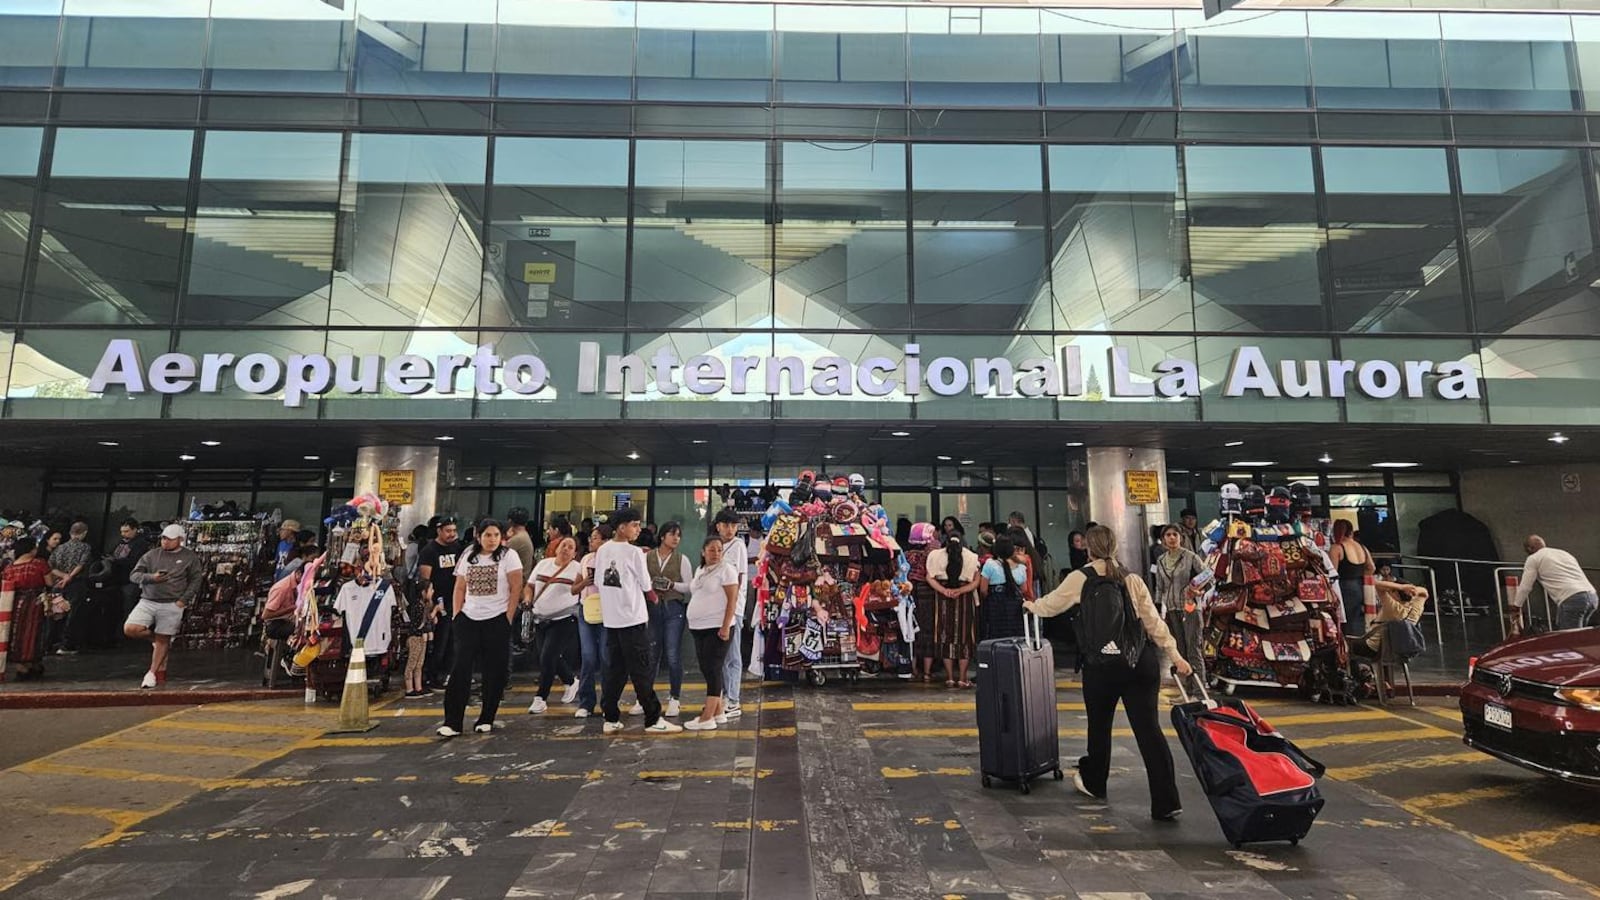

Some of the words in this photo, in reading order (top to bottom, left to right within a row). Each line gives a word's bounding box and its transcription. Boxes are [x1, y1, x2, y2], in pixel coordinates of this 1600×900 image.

[87, 339, 549, 408] Aeropuerto
[577, 341, 1083, 397] Internacional
[1107, 346, 1200, 398] La
[1223, 346, 1480, 399] Aurora
[438, 553, 456, 569] CAT
